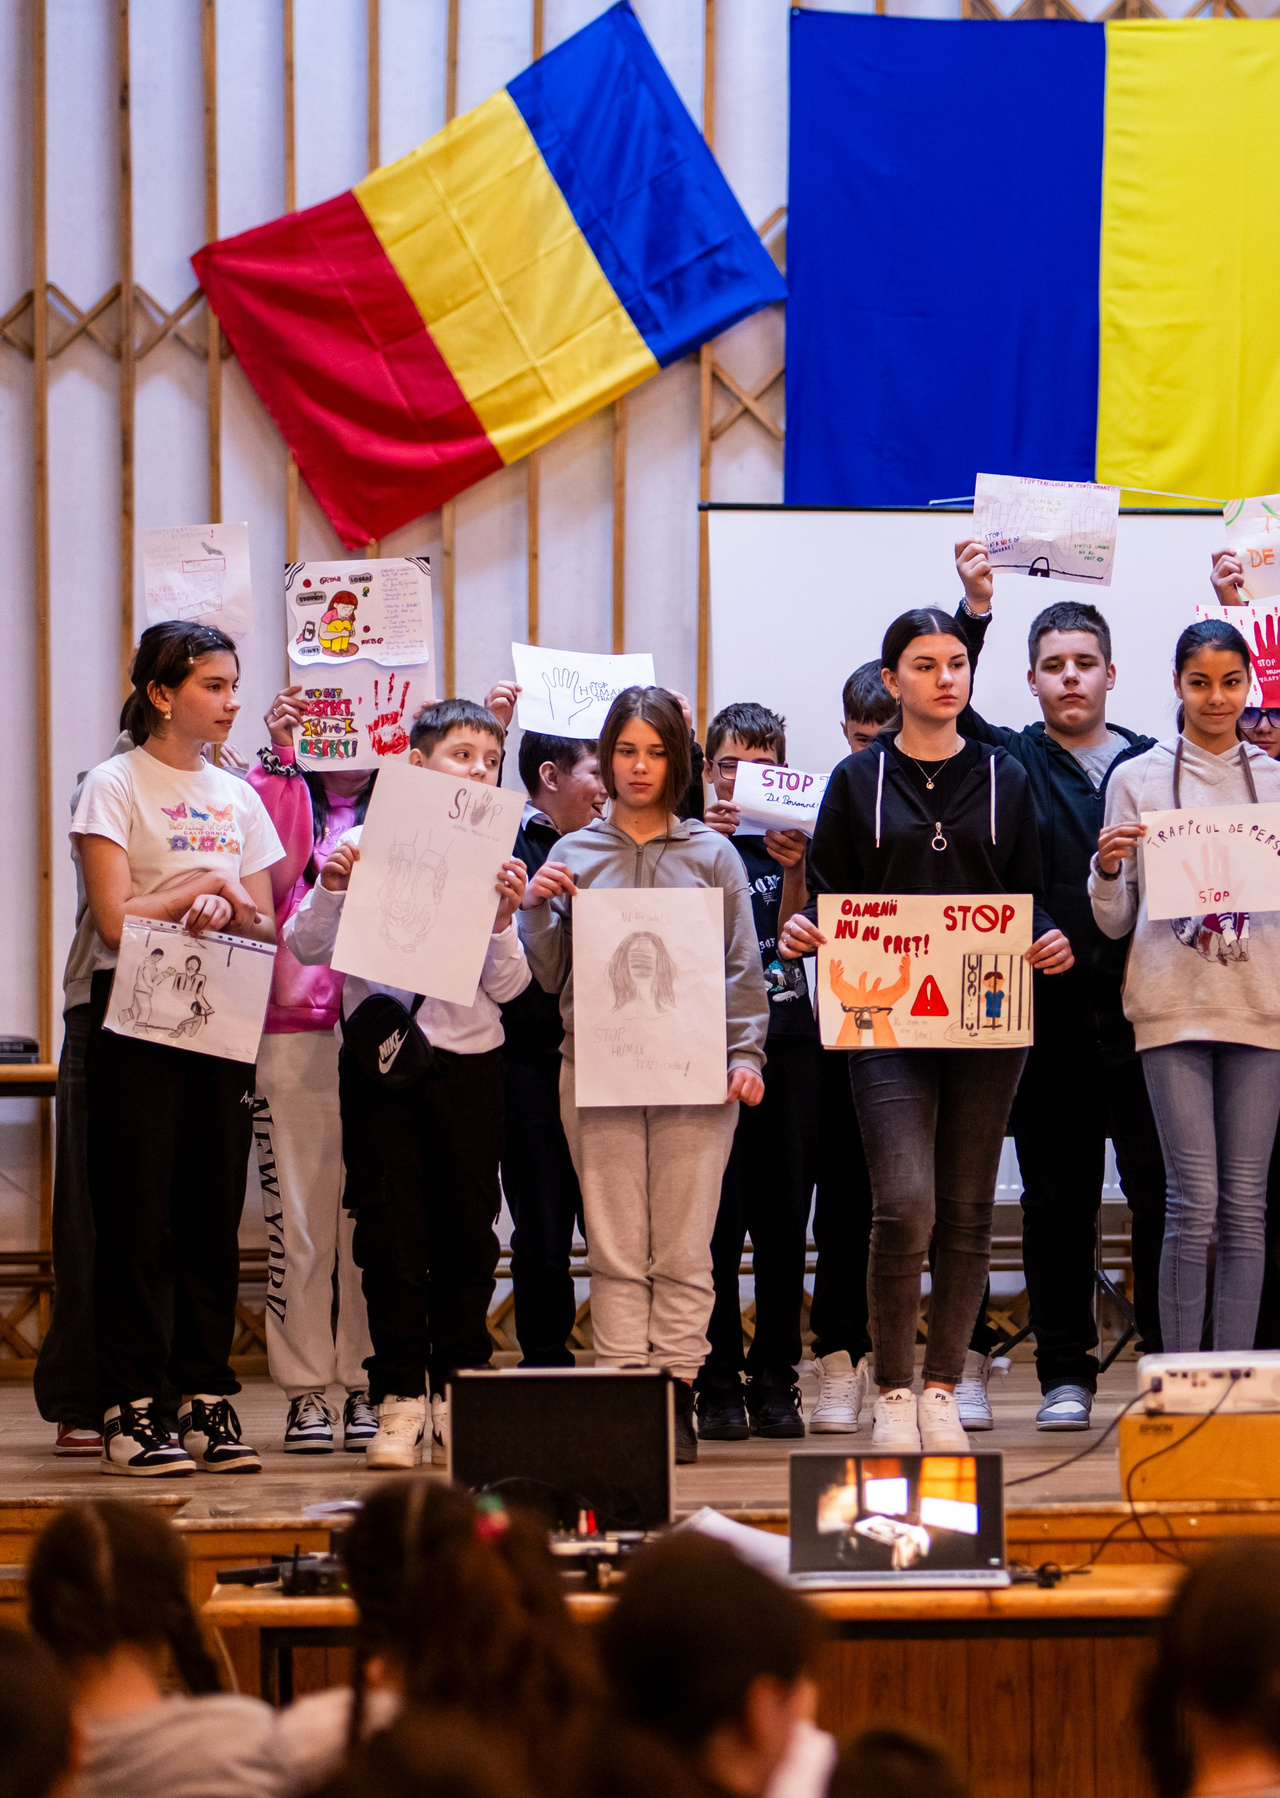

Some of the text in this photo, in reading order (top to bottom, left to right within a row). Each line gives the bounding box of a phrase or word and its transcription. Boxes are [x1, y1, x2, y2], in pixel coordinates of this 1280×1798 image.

[1246, 548, 1275, 568] DE
[1257, 658, 1276, 667] STOP
[590, 681, 608, 689] STOP
[762, 769, 814, 793] STOP
[1228, 823, 1244, 834] DE
[1198, 888, 1230, 904] STOP
[943, 904, 1015, 934] STOP
[835, 919, 859, 939] NU
[861, 926, 880, 941] AU
[594, 1026, 626, 1044] STOP
[379, 1029, 400, 1061] NIKE
[612, 1043, 644, 1058] HUMAN
[252, 1096, 282, 1199] NEW
[1139, 1423, 1173, 1434] EPSON
